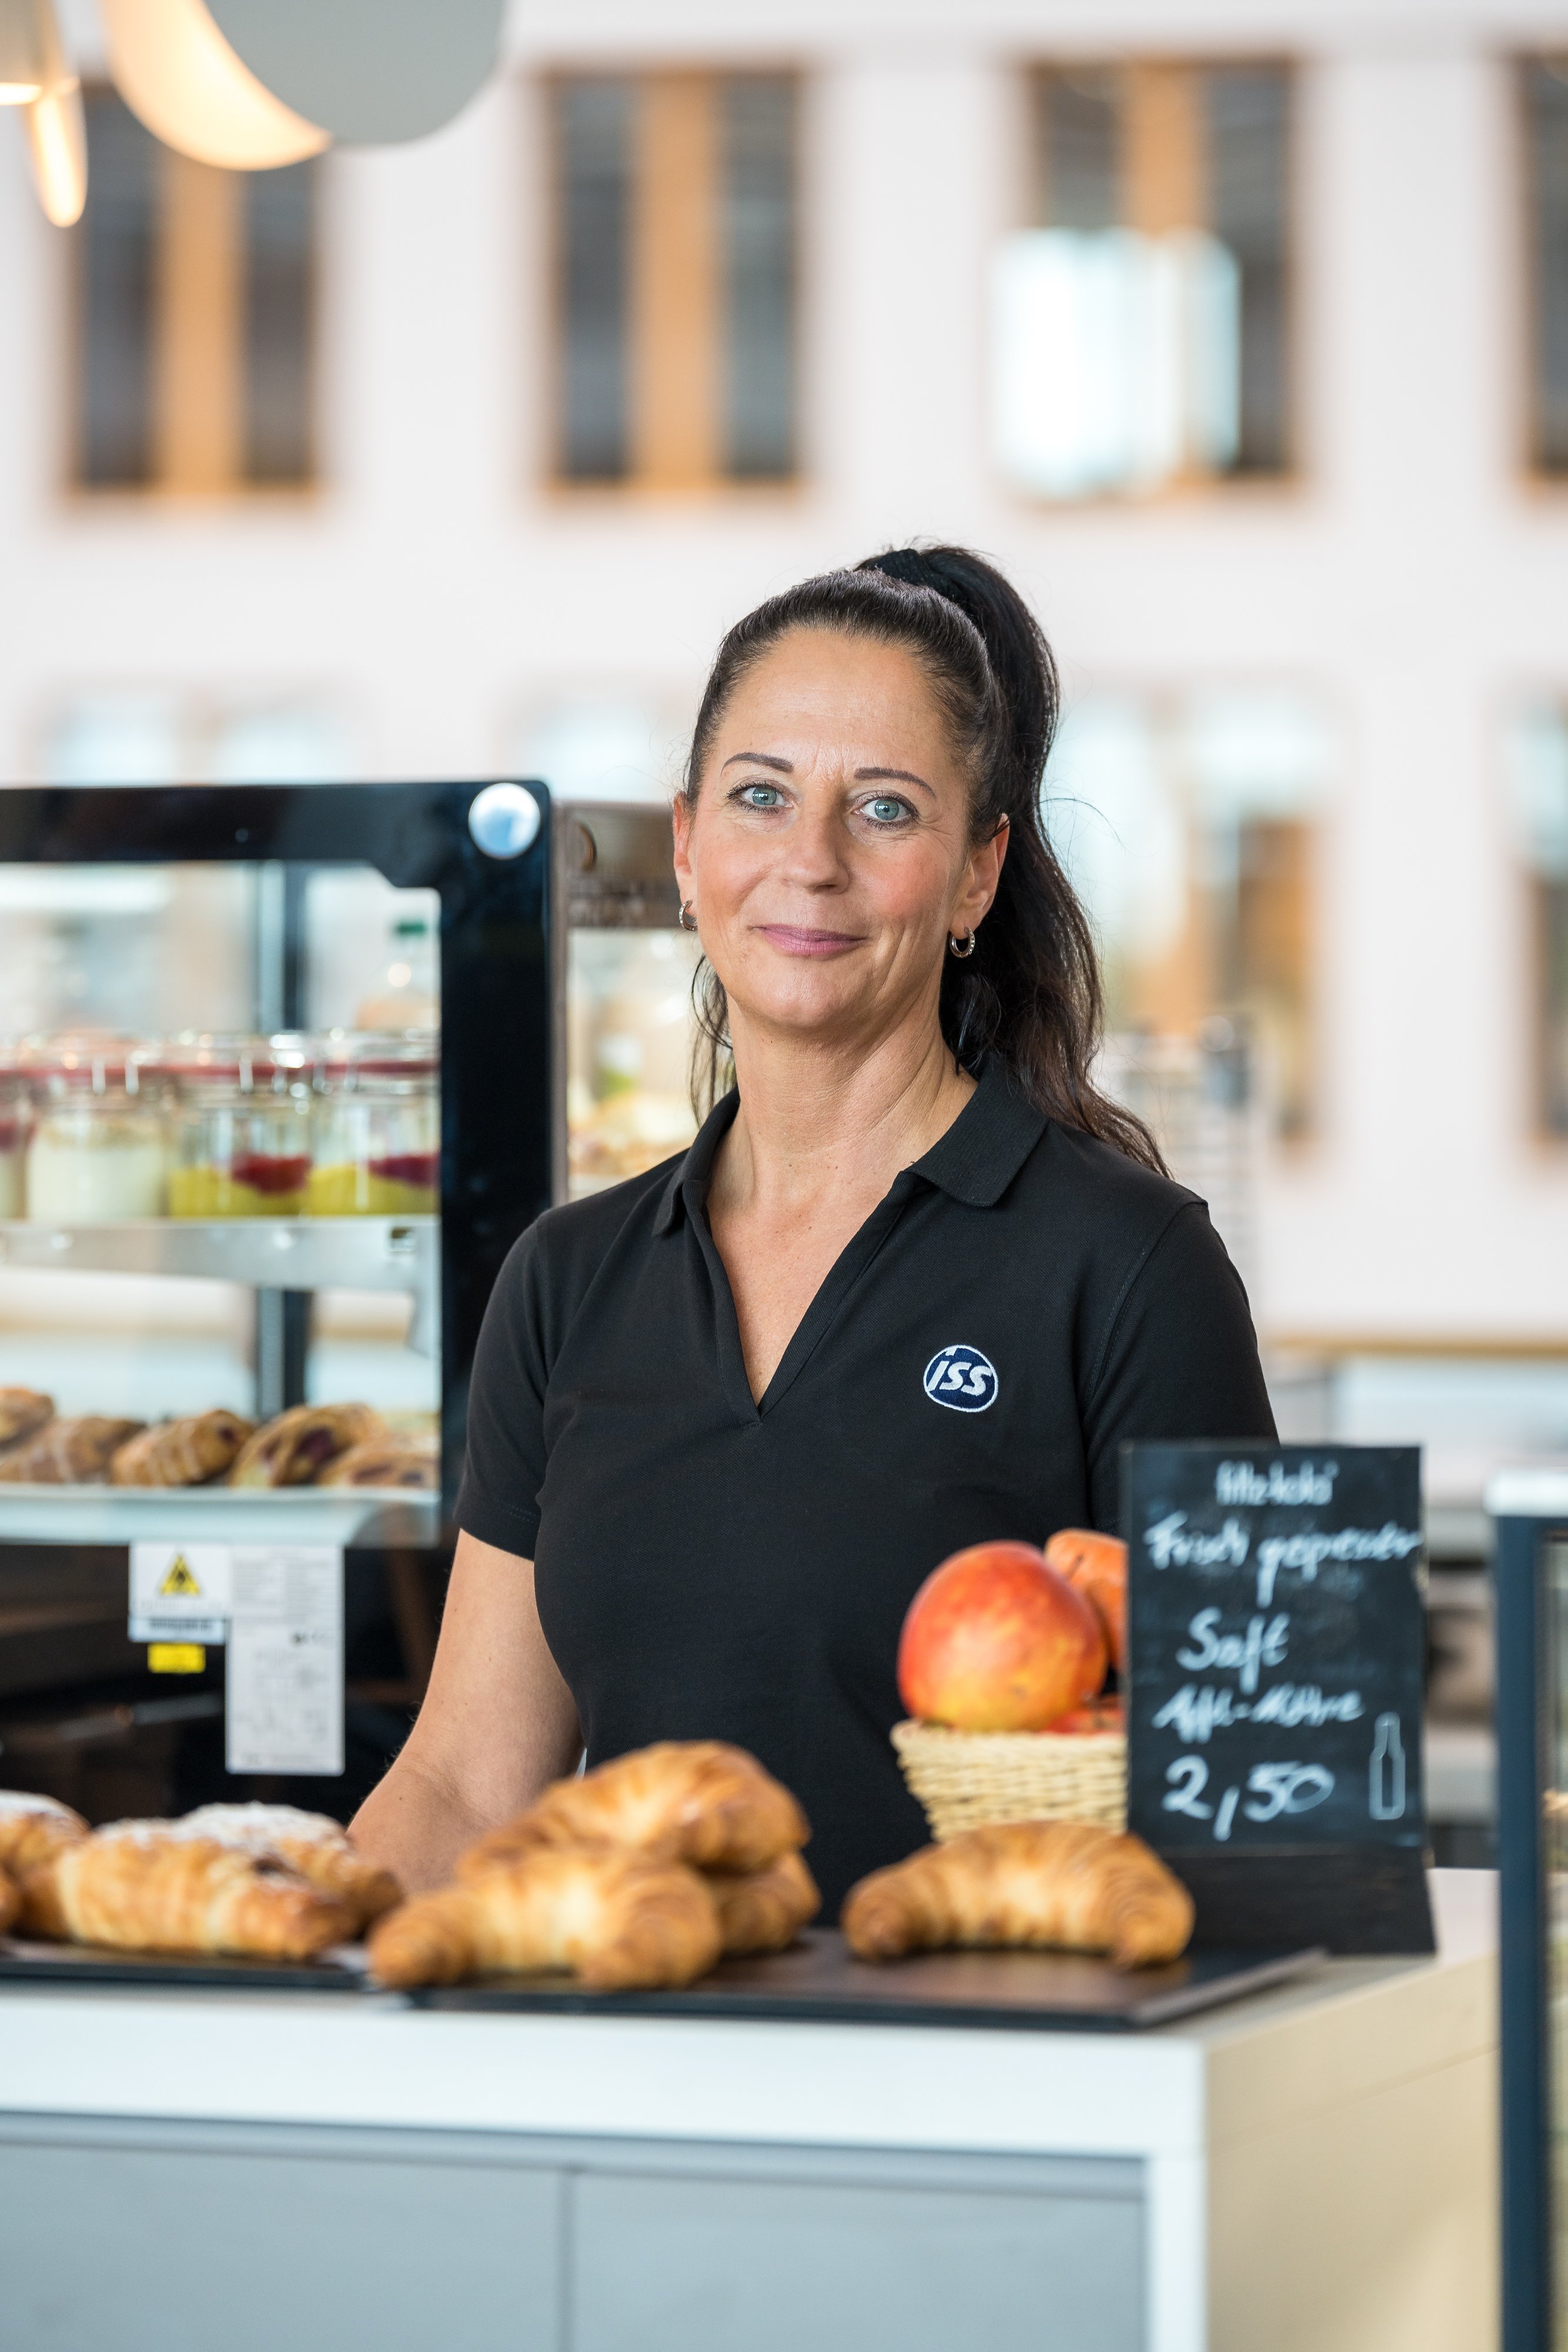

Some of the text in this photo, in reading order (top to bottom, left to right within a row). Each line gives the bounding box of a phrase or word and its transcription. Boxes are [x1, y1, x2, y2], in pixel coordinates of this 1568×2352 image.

[927, 1347, 994, 1396] iss
[1178, 1606, 1290, 1694] Saft
[1162, 1755, 1335, 1841] 2,50
